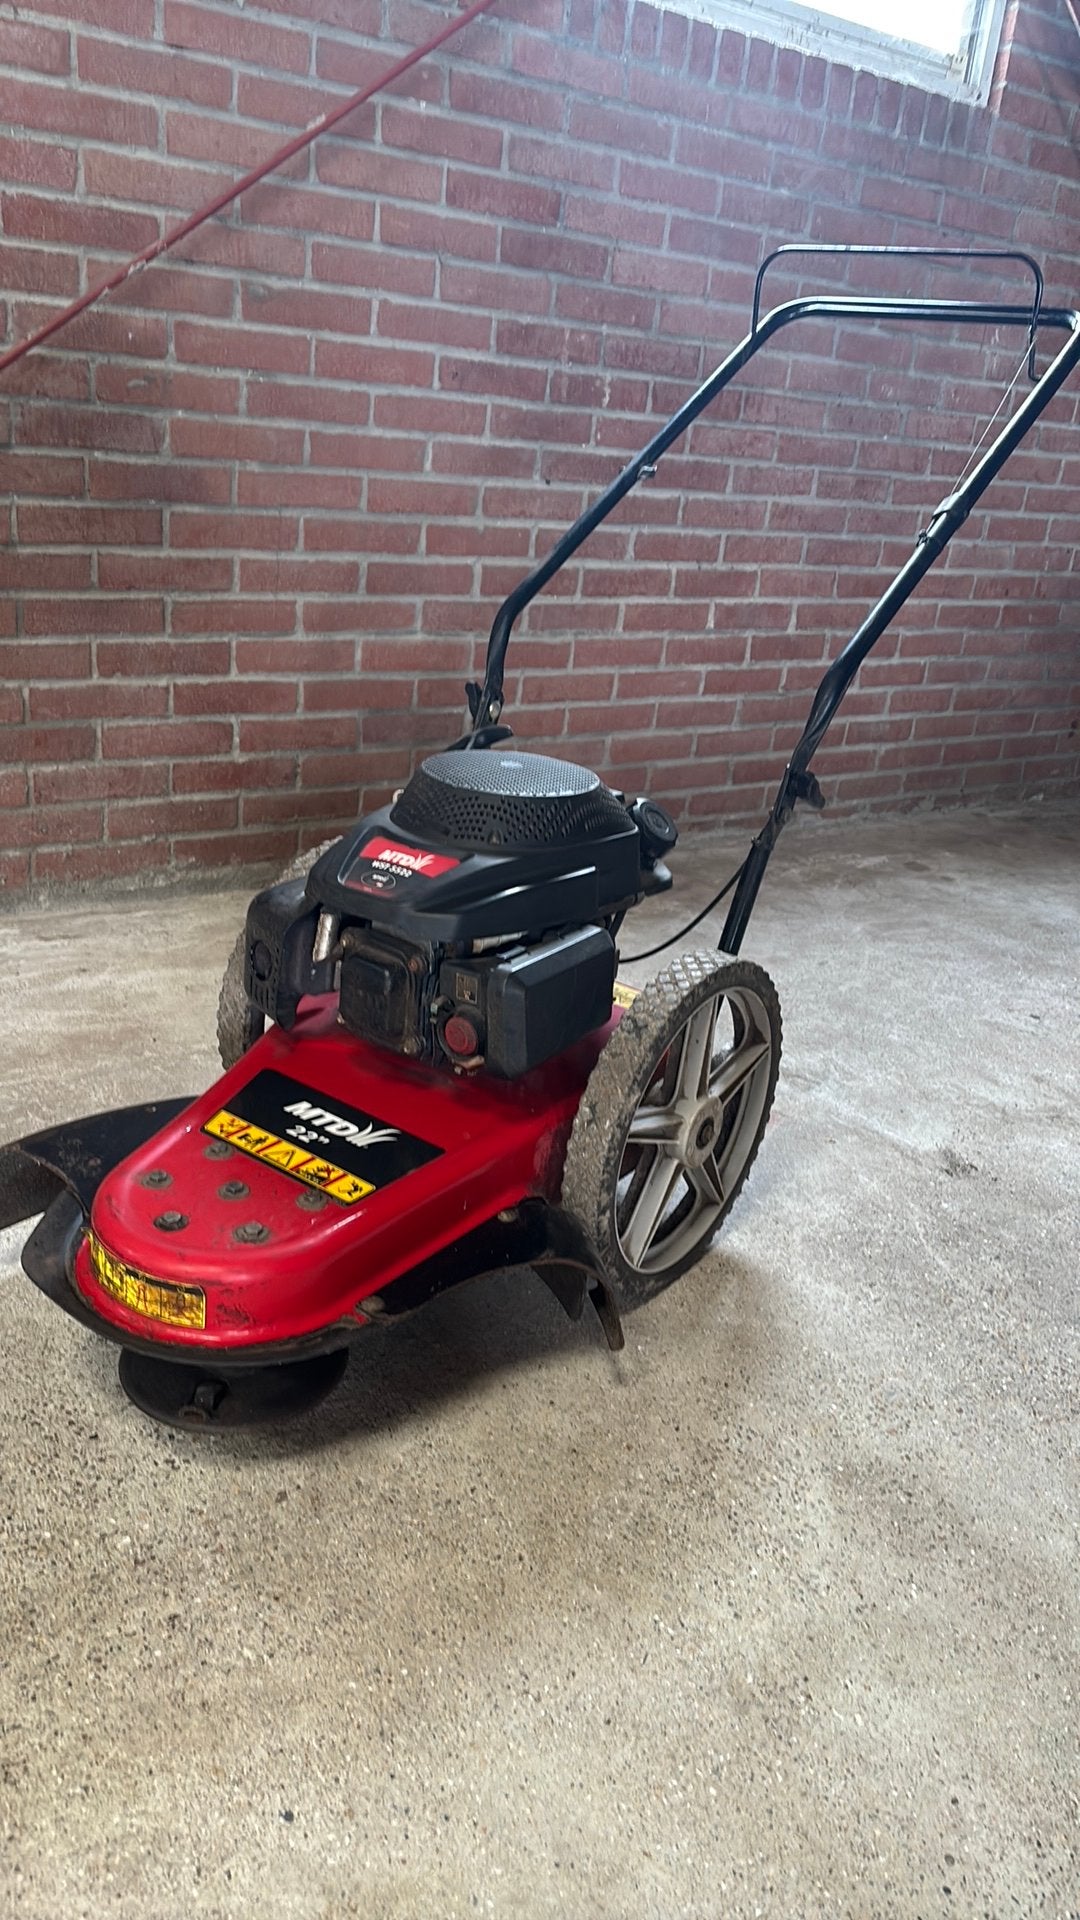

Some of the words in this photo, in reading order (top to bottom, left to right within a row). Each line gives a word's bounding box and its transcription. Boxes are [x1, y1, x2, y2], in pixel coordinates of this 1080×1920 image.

[378, 849, 419, 870] MTD
[283, 1100, 360, 1143] MTD
[286, 1125, 330, 1144] 22"
